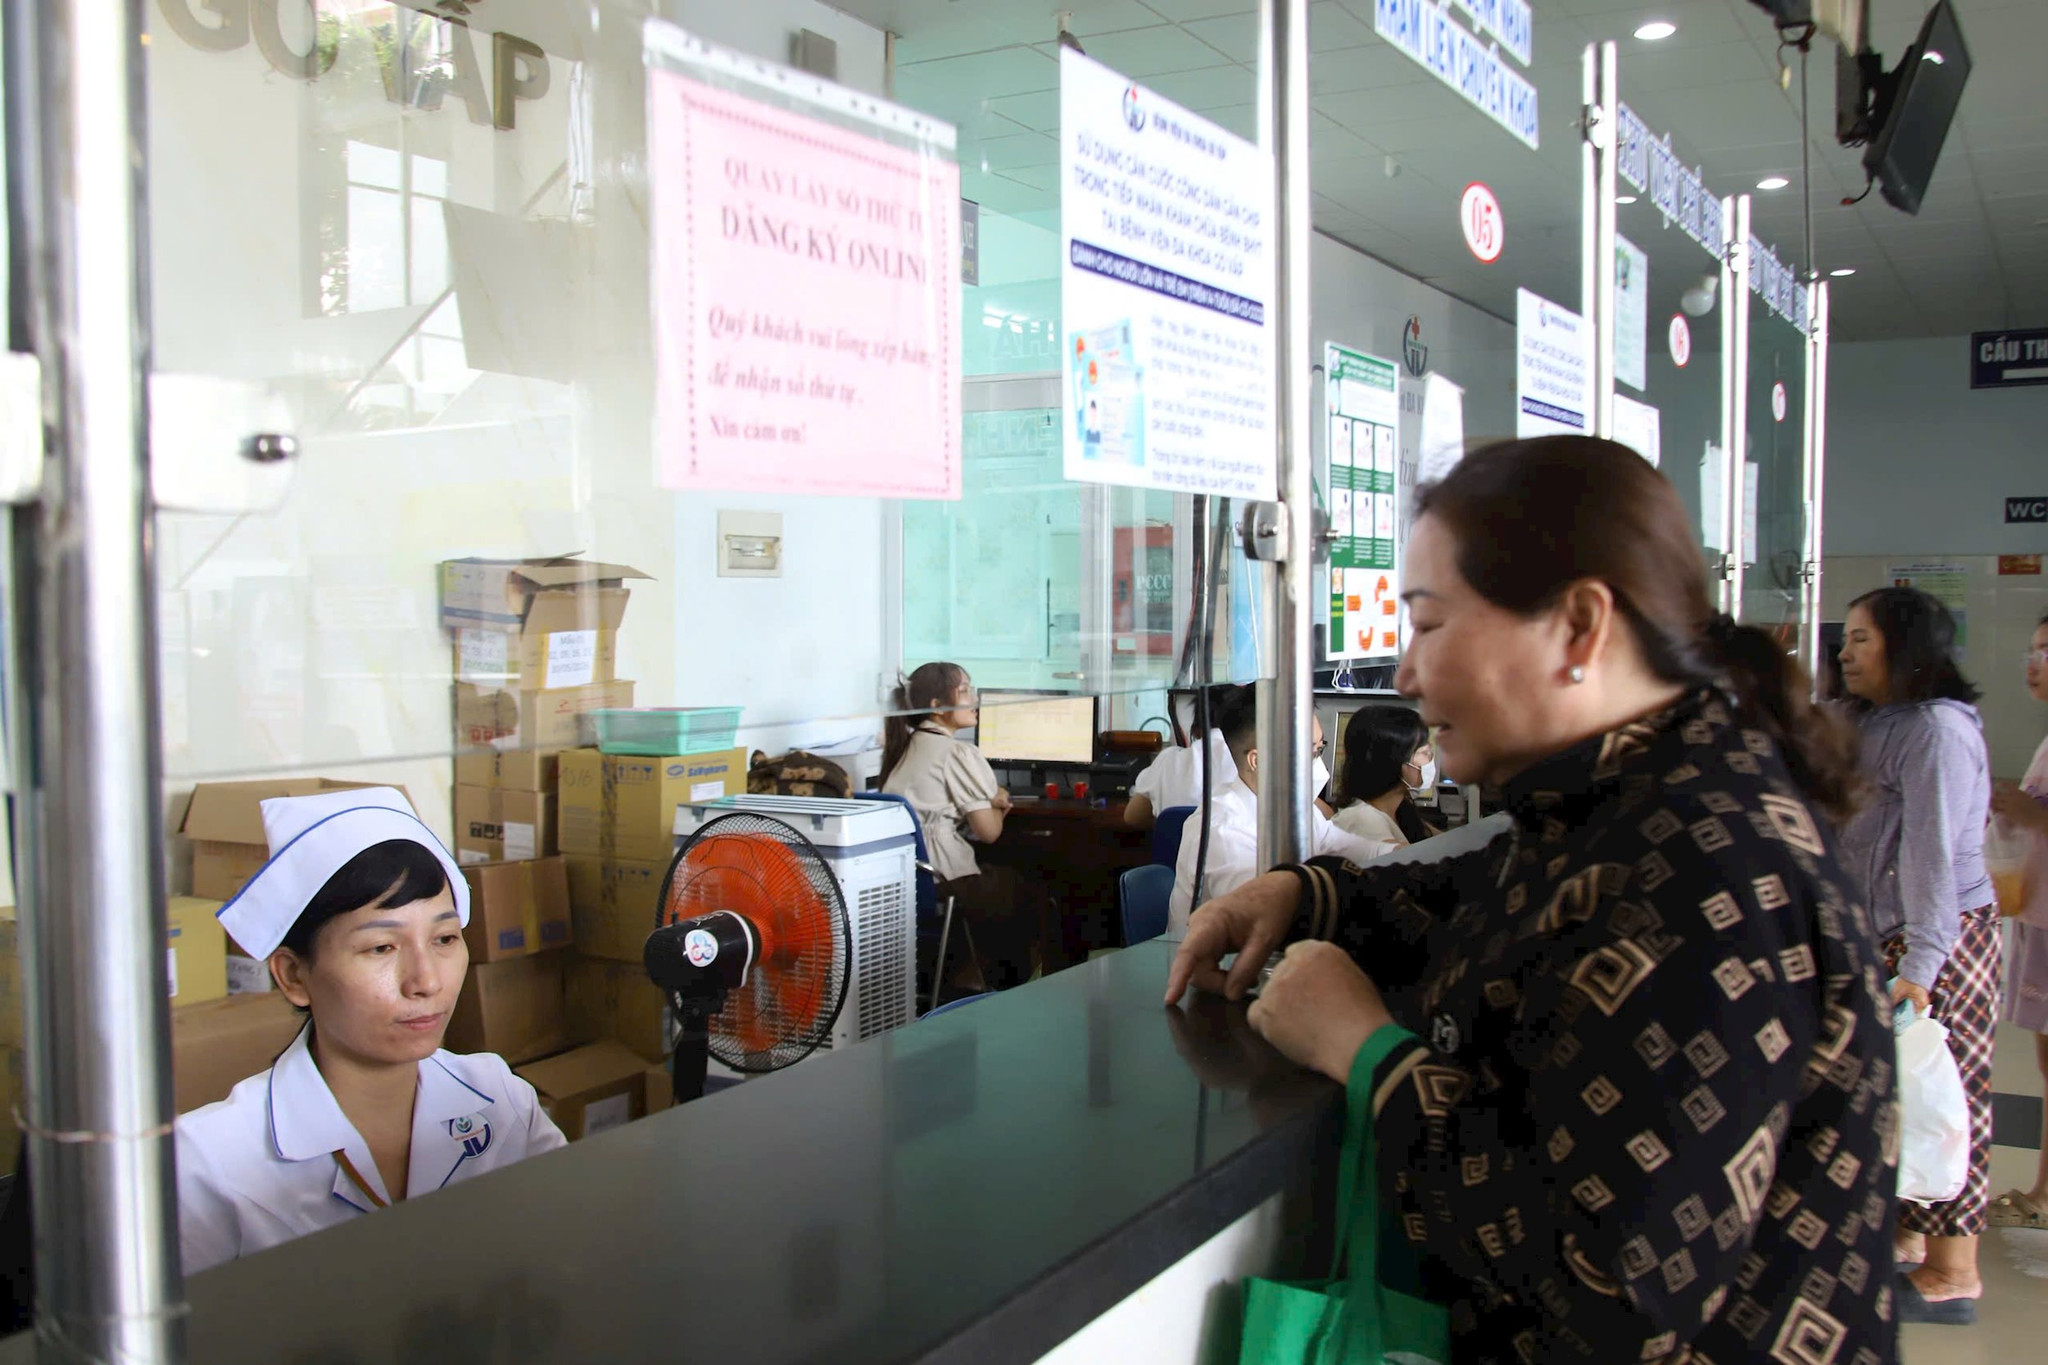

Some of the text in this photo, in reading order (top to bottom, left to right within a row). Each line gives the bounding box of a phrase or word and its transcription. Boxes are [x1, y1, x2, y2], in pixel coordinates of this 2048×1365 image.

[1471, 195, 1493, 250] 05
[2009, 502, 2046, 518] WC
[1136, 574, 1171, 590] PCCC
